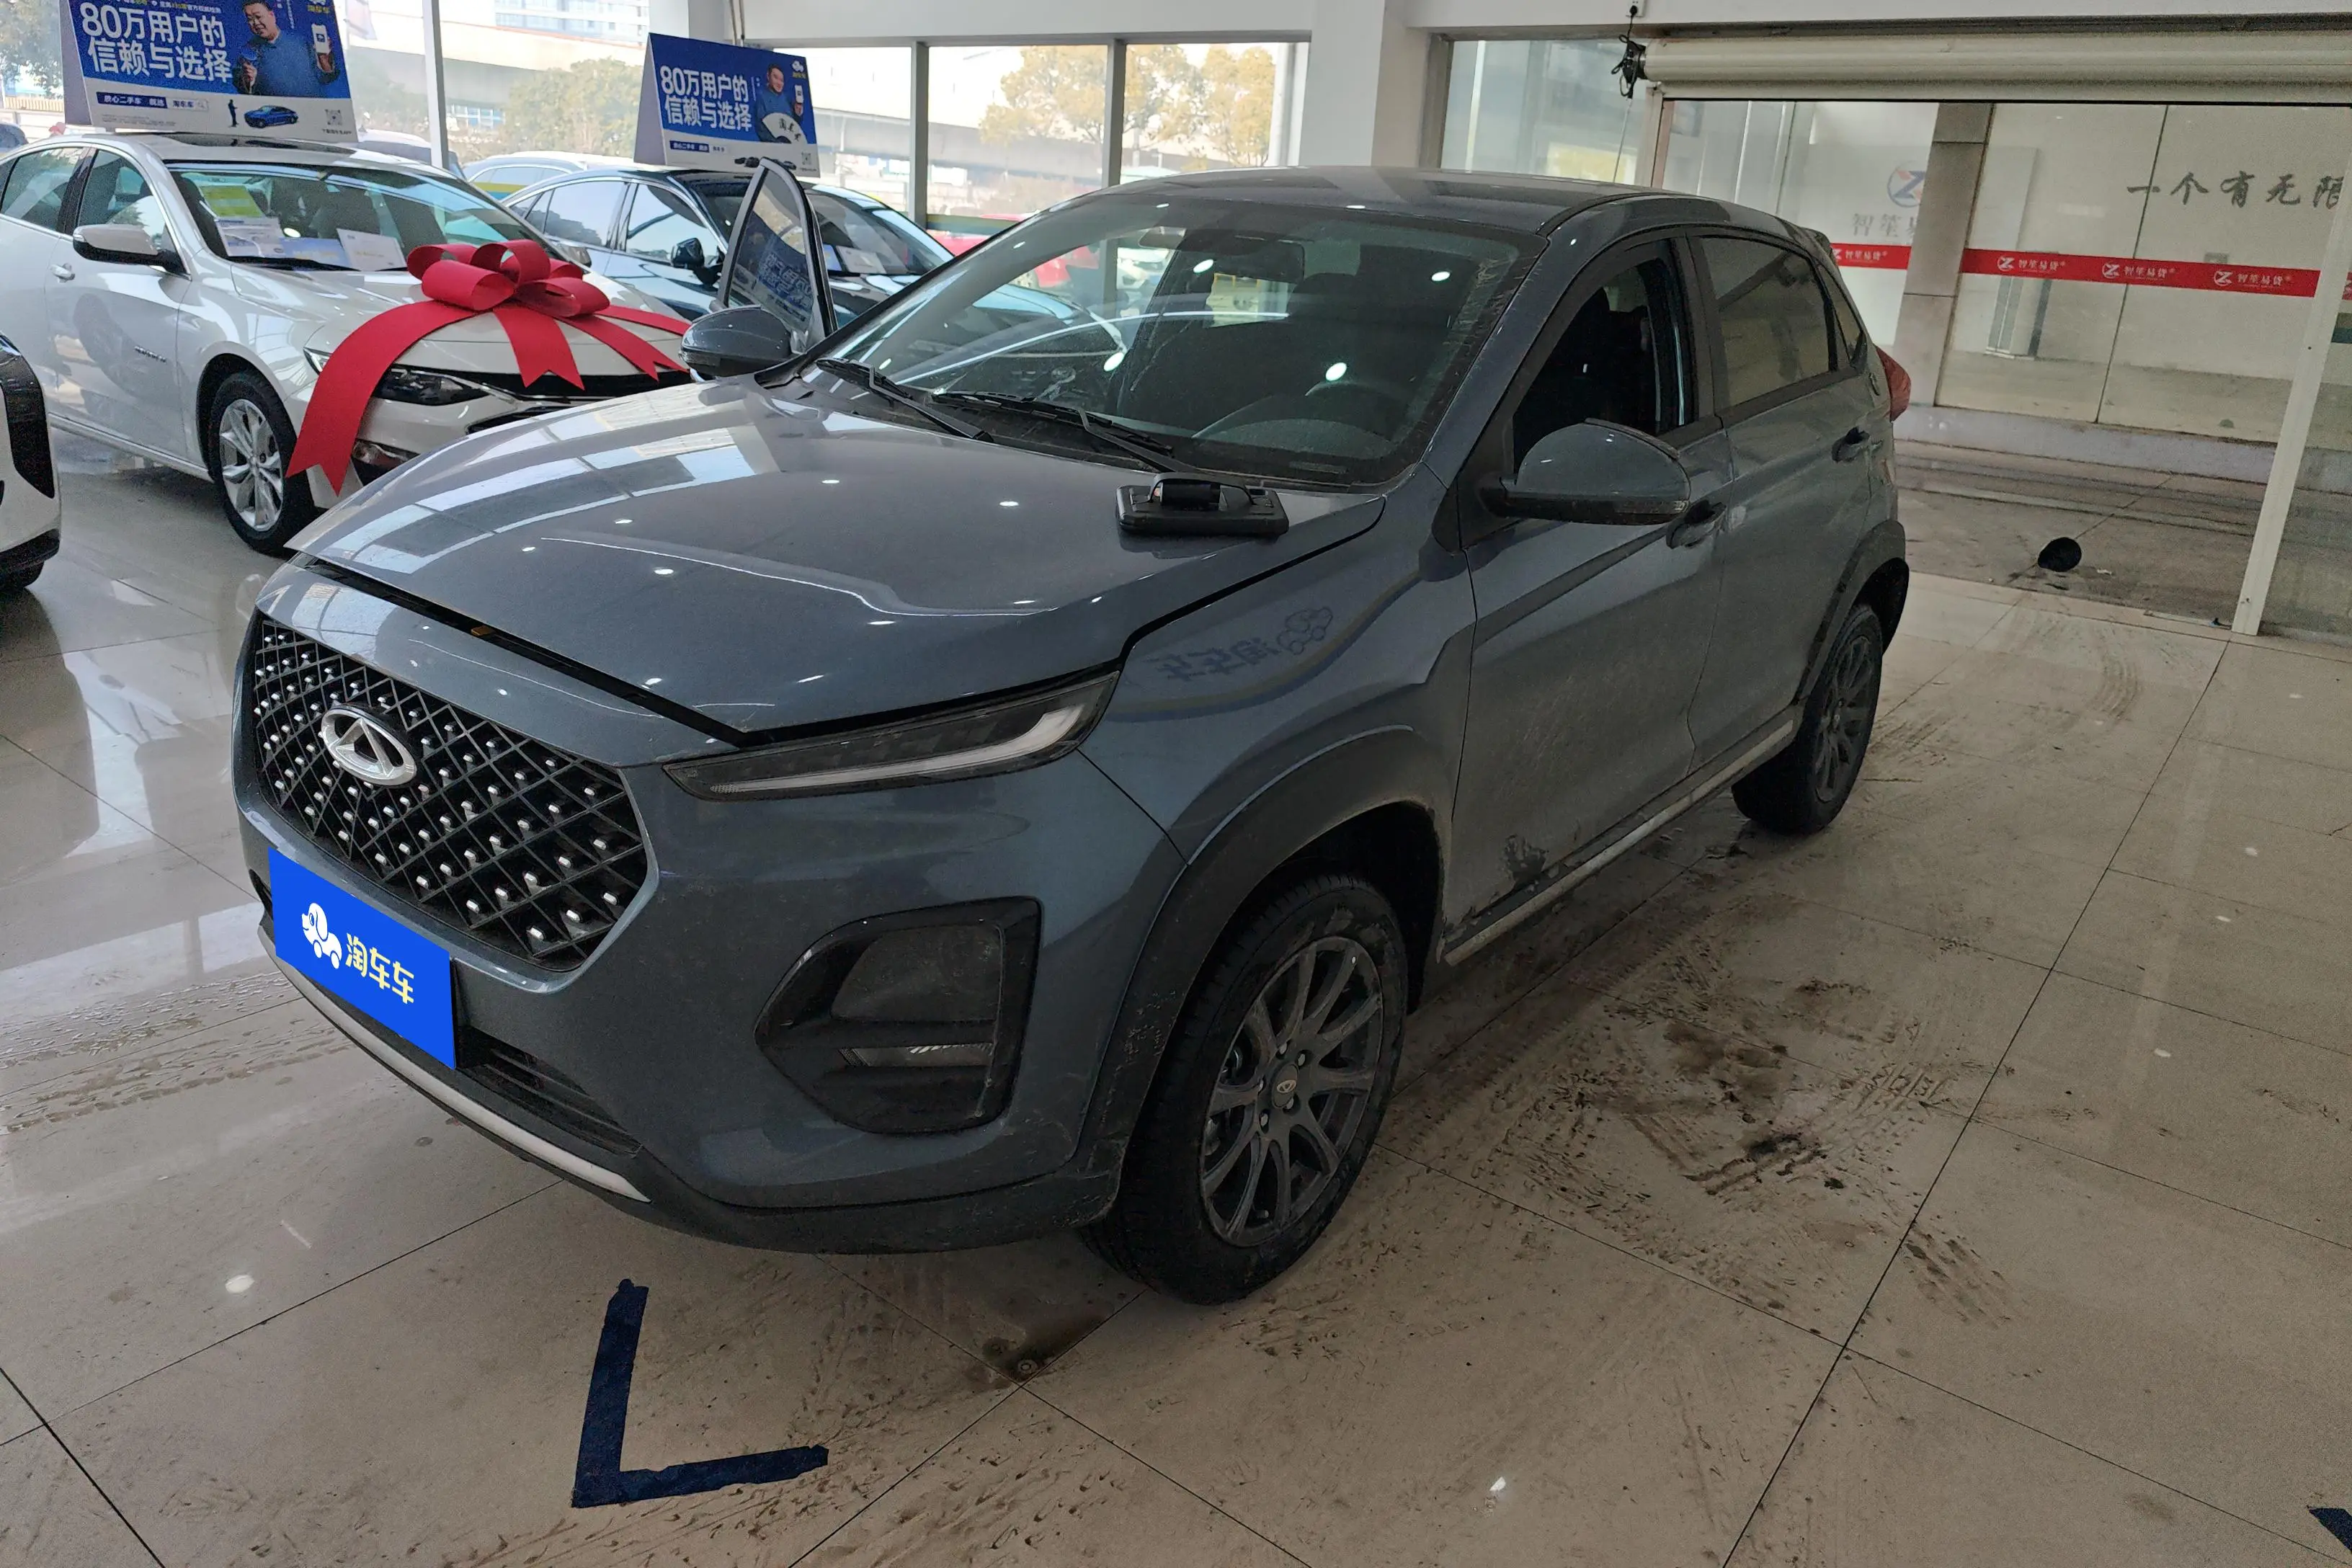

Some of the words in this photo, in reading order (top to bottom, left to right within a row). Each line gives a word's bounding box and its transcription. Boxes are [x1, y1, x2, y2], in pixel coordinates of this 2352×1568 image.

[80, 2, 226, 48] 80万用户的
[88, 36, 234, 83] 信赖与选择
[659, 66, 749, 102] 80万用户的
[664, 94, 752, 132] 信赖与选择
